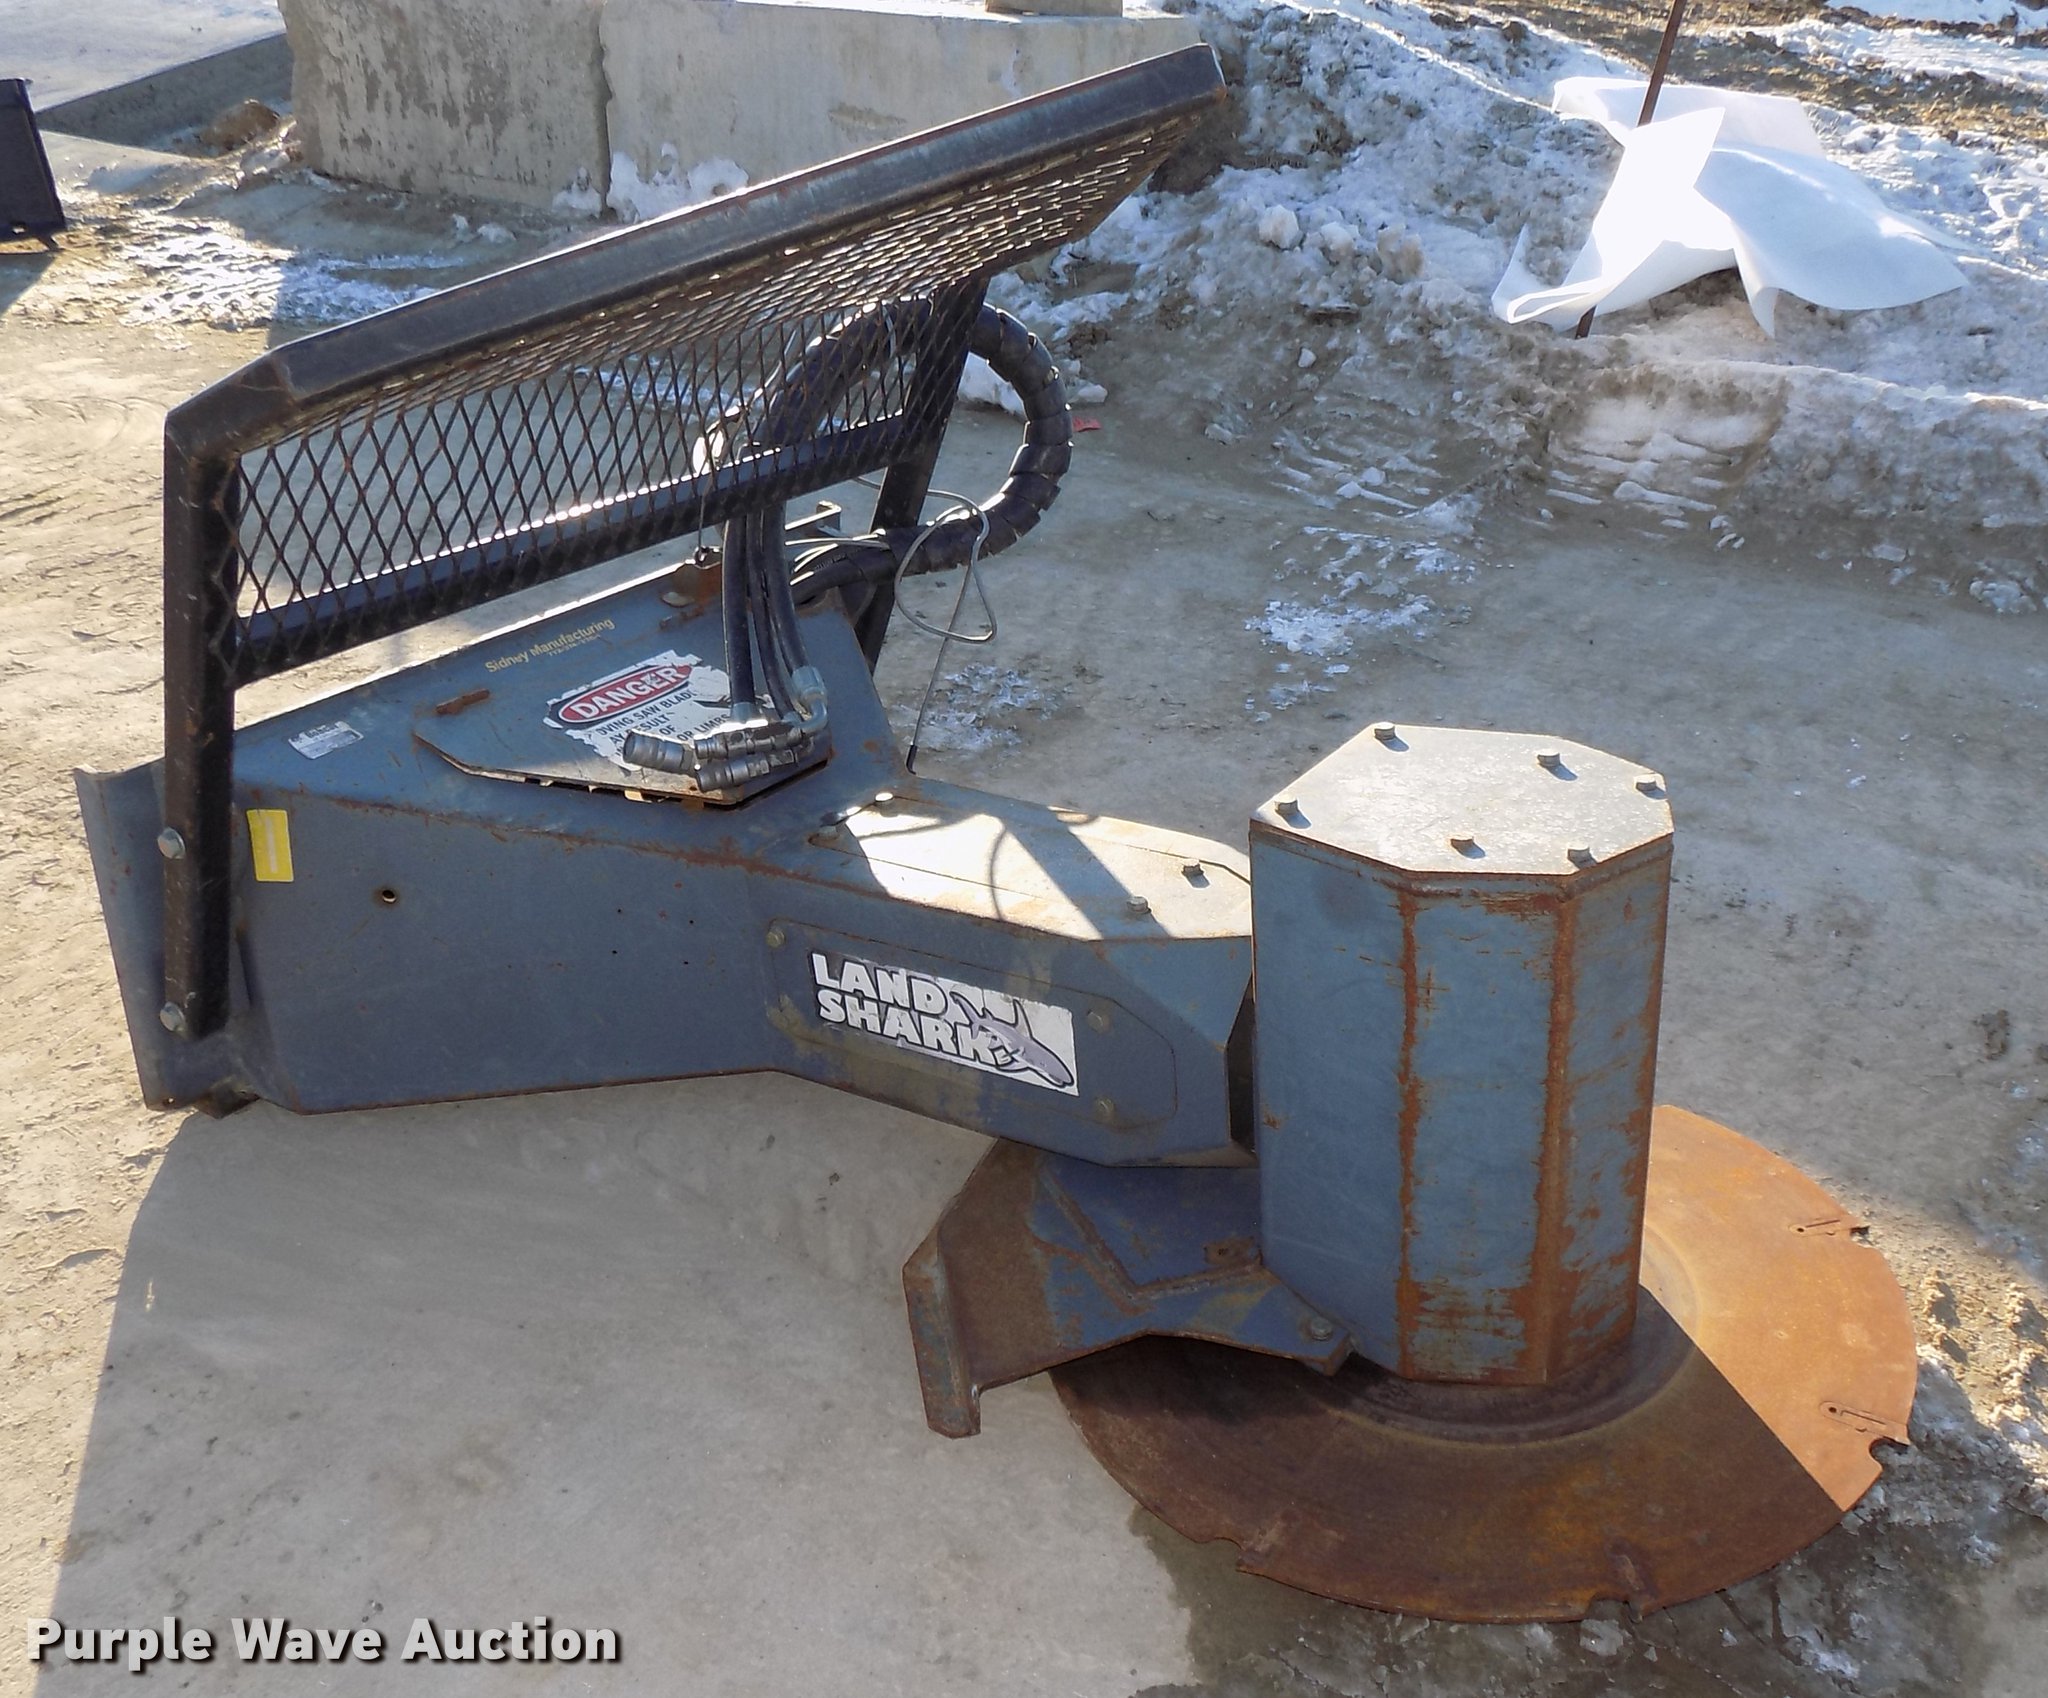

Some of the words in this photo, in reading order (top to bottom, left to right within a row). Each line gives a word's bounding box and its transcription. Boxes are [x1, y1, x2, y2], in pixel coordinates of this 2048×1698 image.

[485, 651, 529, 673] Sidney
[530, 619, 616, 656] Manufacturing
[570, 667, 688, 718] DANGER
[590, 717, 634, 738] OVING
[633, 704, 661, 720] SAW
[659, 724, 676, 736] OF
[810, 952, 949, 1015] LAND
[816, 988, 1000, 1067] SHARK
